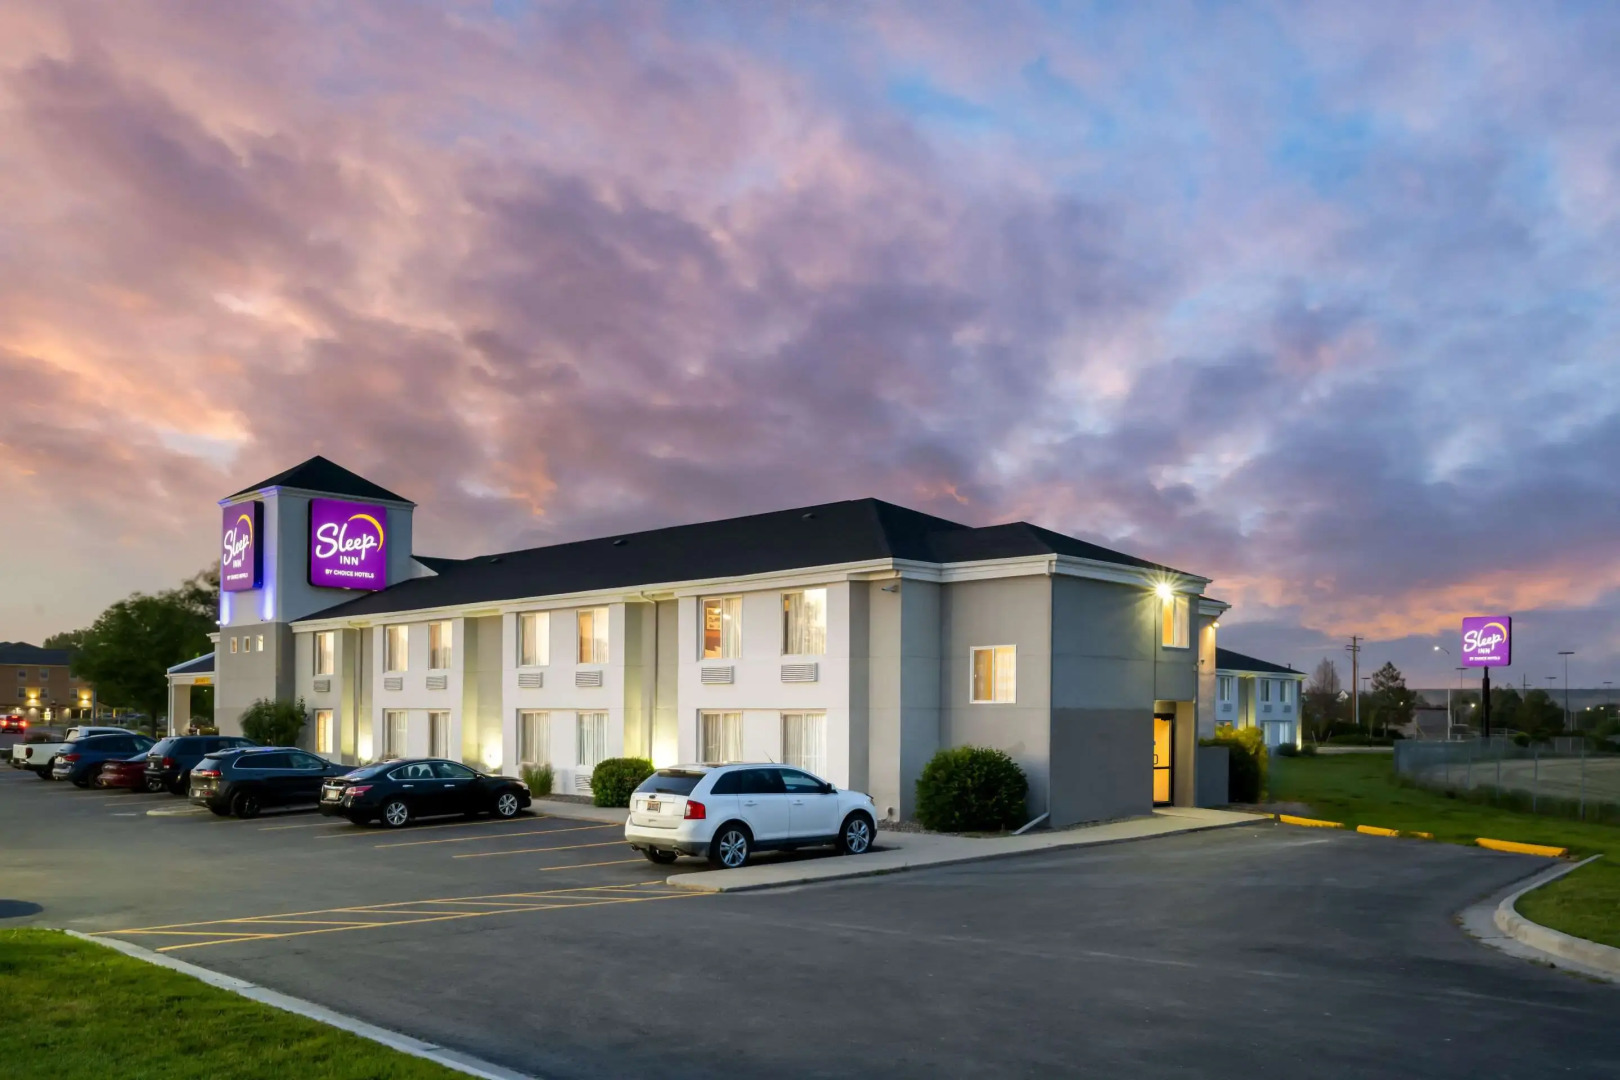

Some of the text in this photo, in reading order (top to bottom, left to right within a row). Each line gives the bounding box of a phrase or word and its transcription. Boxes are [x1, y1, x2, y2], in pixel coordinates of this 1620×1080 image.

[224, 528, 250, 566] Sleep
[316, 522, 378, 560] Sleep
[232, 559, 242, 568] INN
[340, 556, 358, 566] INN
[333, 569, 354, 577] CHOICE
[354, 571, 375, 579] HOTELS
[1464, 629, 1502, 652] Sleep
